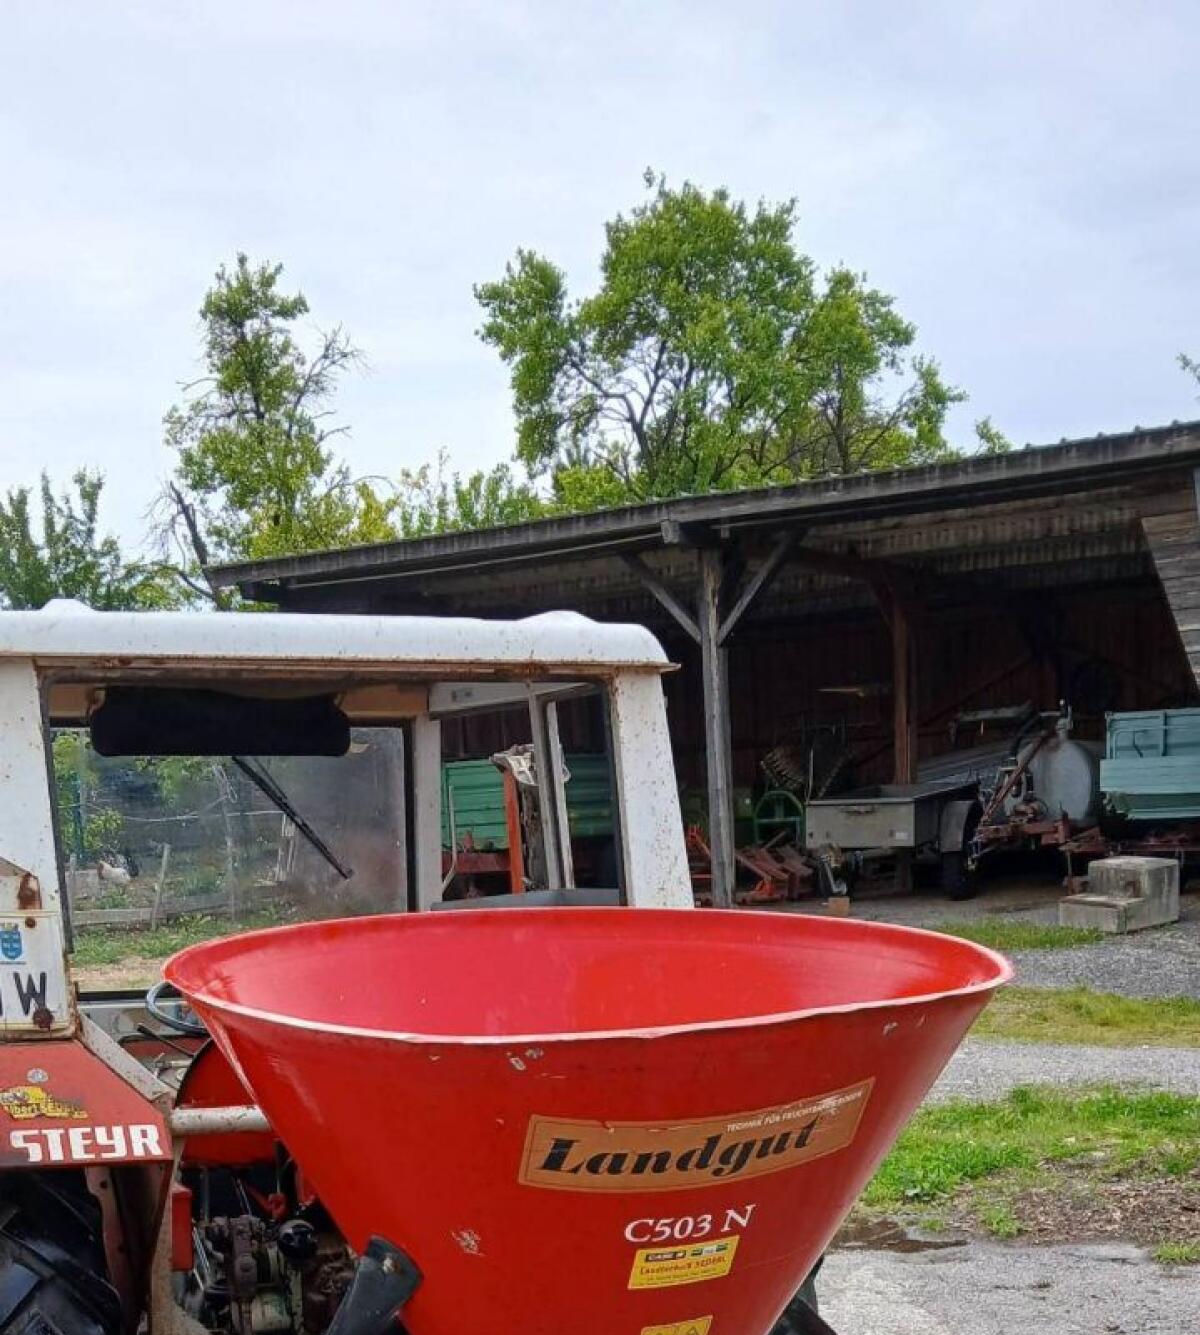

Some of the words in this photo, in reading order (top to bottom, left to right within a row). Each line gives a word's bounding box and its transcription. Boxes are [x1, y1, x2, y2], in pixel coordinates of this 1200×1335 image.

[0, 970, 47, 1017] W
[10, 1124, 163, 1162] STEYR
[536, 1114, 820, 1177] Landgut
[624, 1214, 712, 1243] C503
[720, 1204, 757, 1233] N
